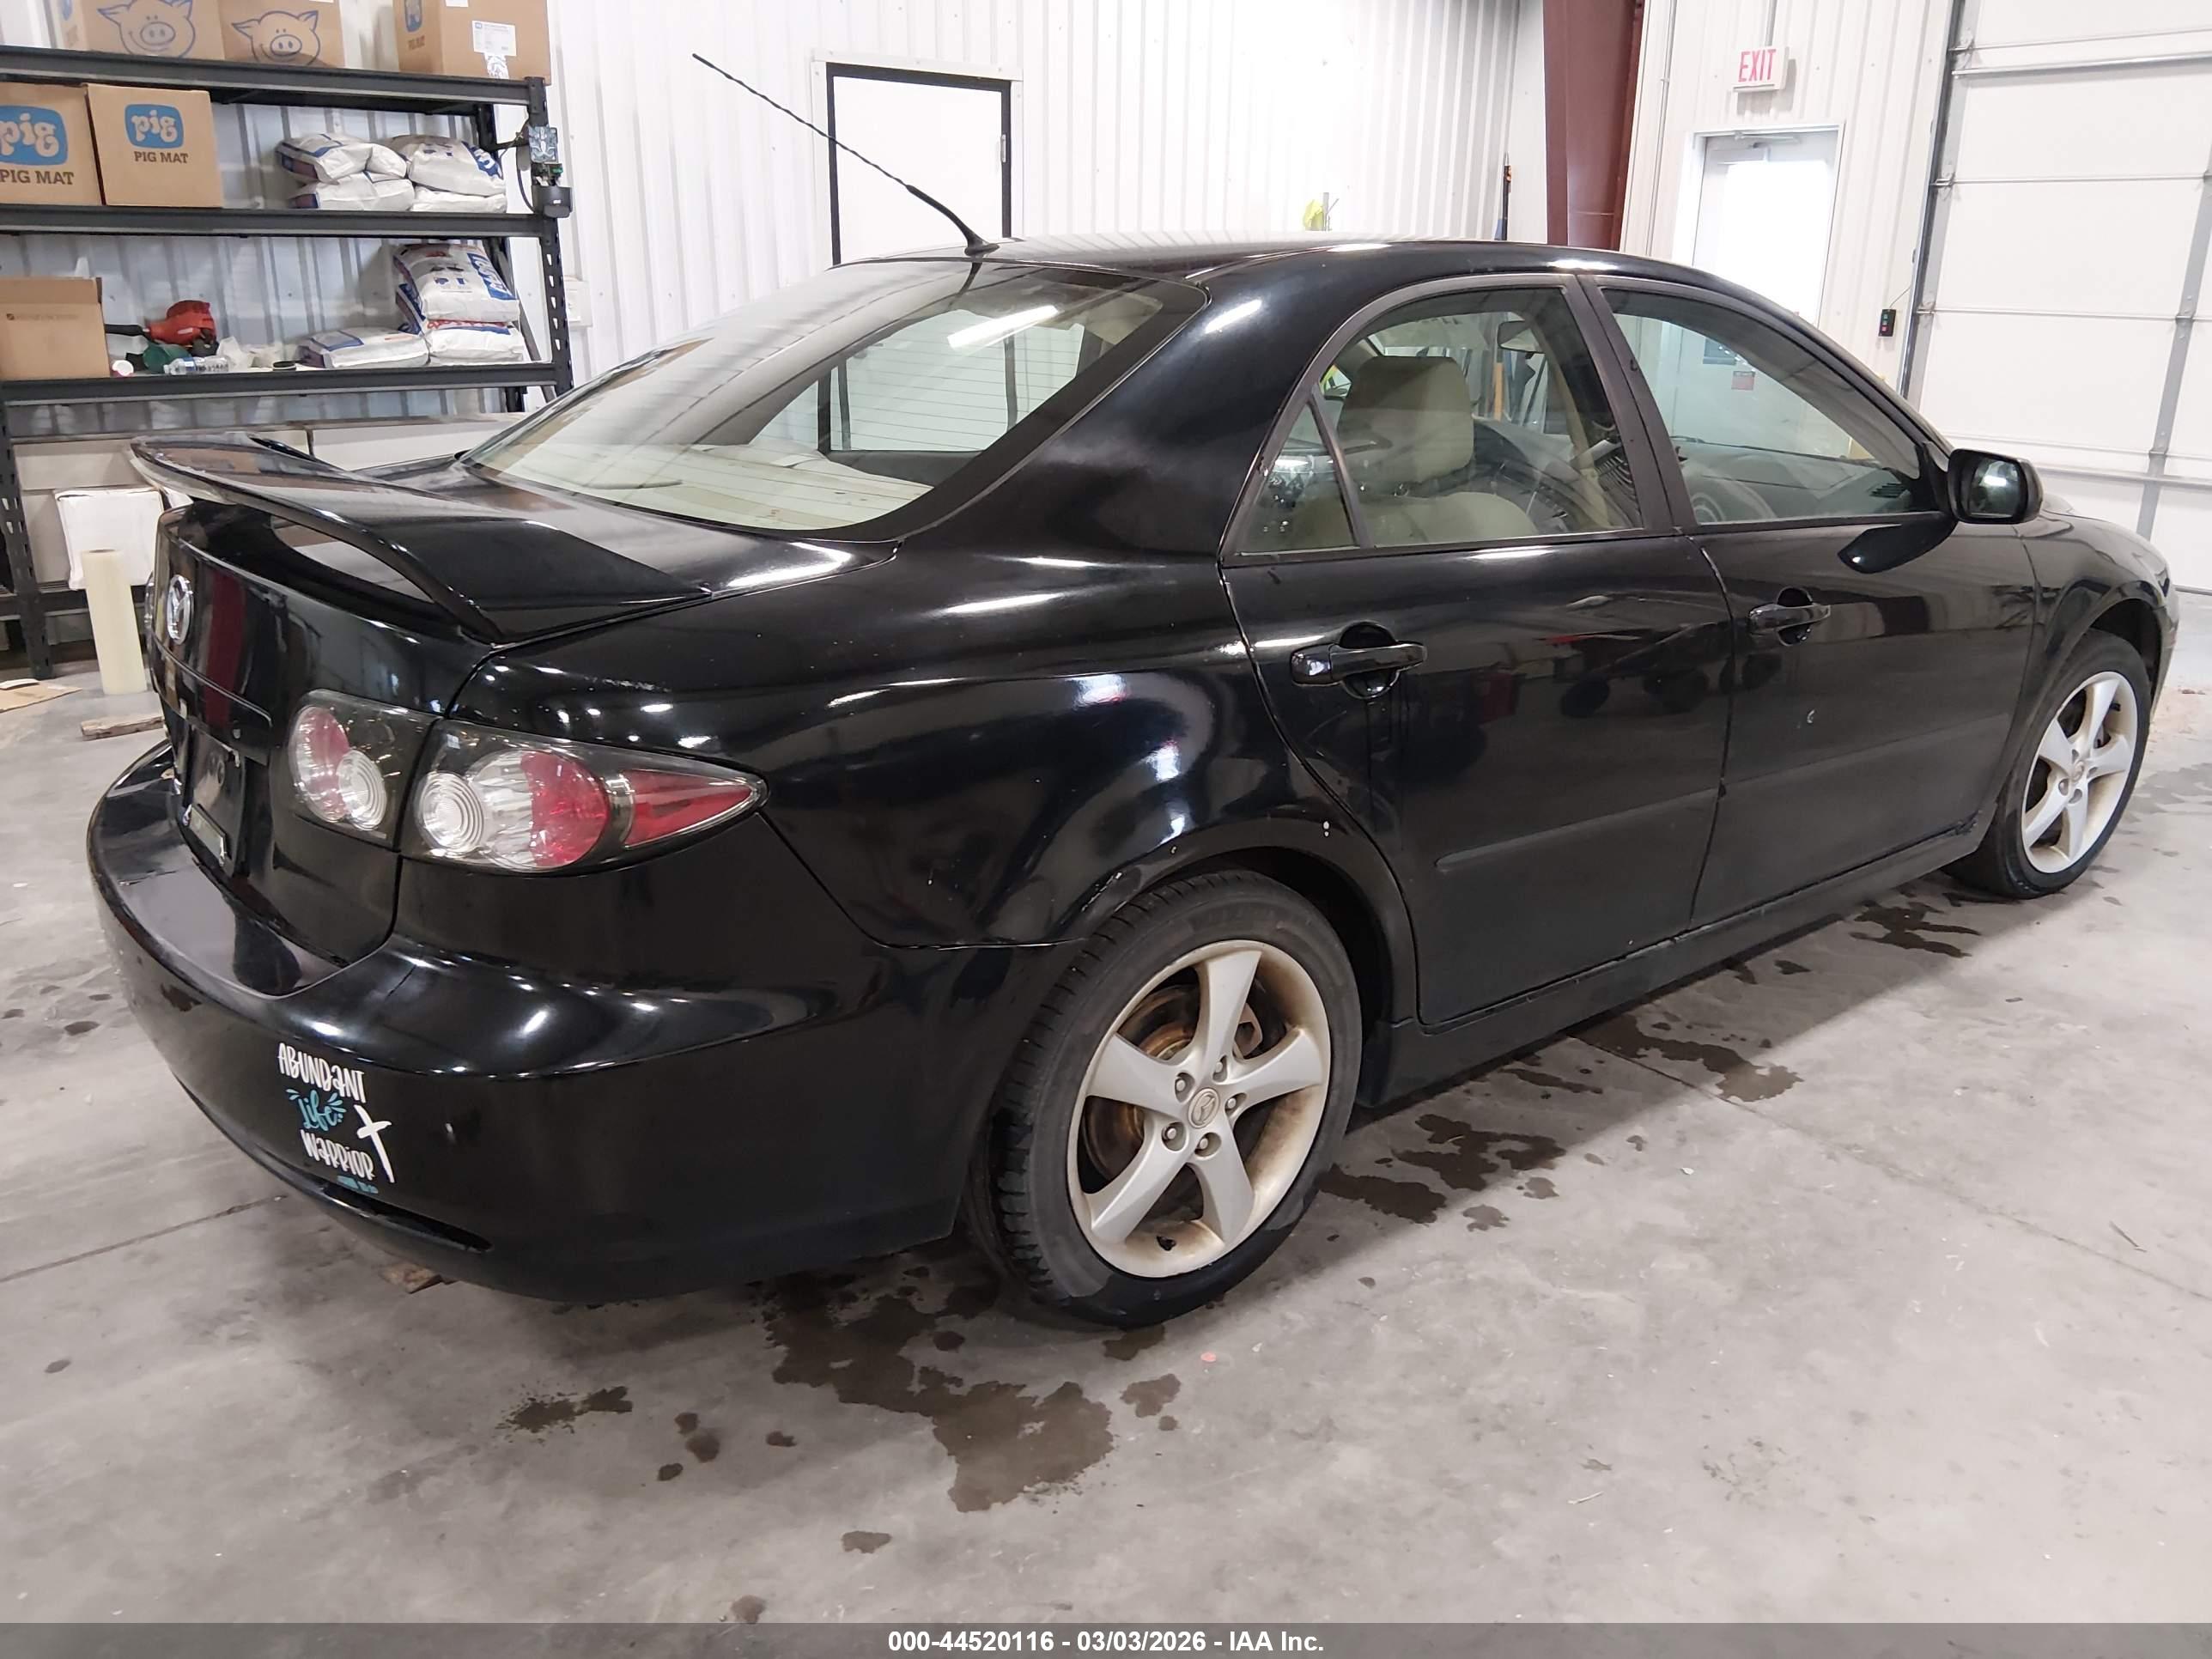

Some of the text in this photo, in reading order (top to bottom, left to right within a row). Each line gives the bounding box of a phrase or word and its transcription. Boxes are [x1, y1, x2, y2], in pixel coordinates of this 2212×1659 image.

[1738, 49, 1777, 82] EXIT
[0, 112, 59, 158] pig
[131, 109, 177, 143] pig
[134, 150, 189, 164] PIG MAT
[0, 168, 75, 185] PIG MAT
